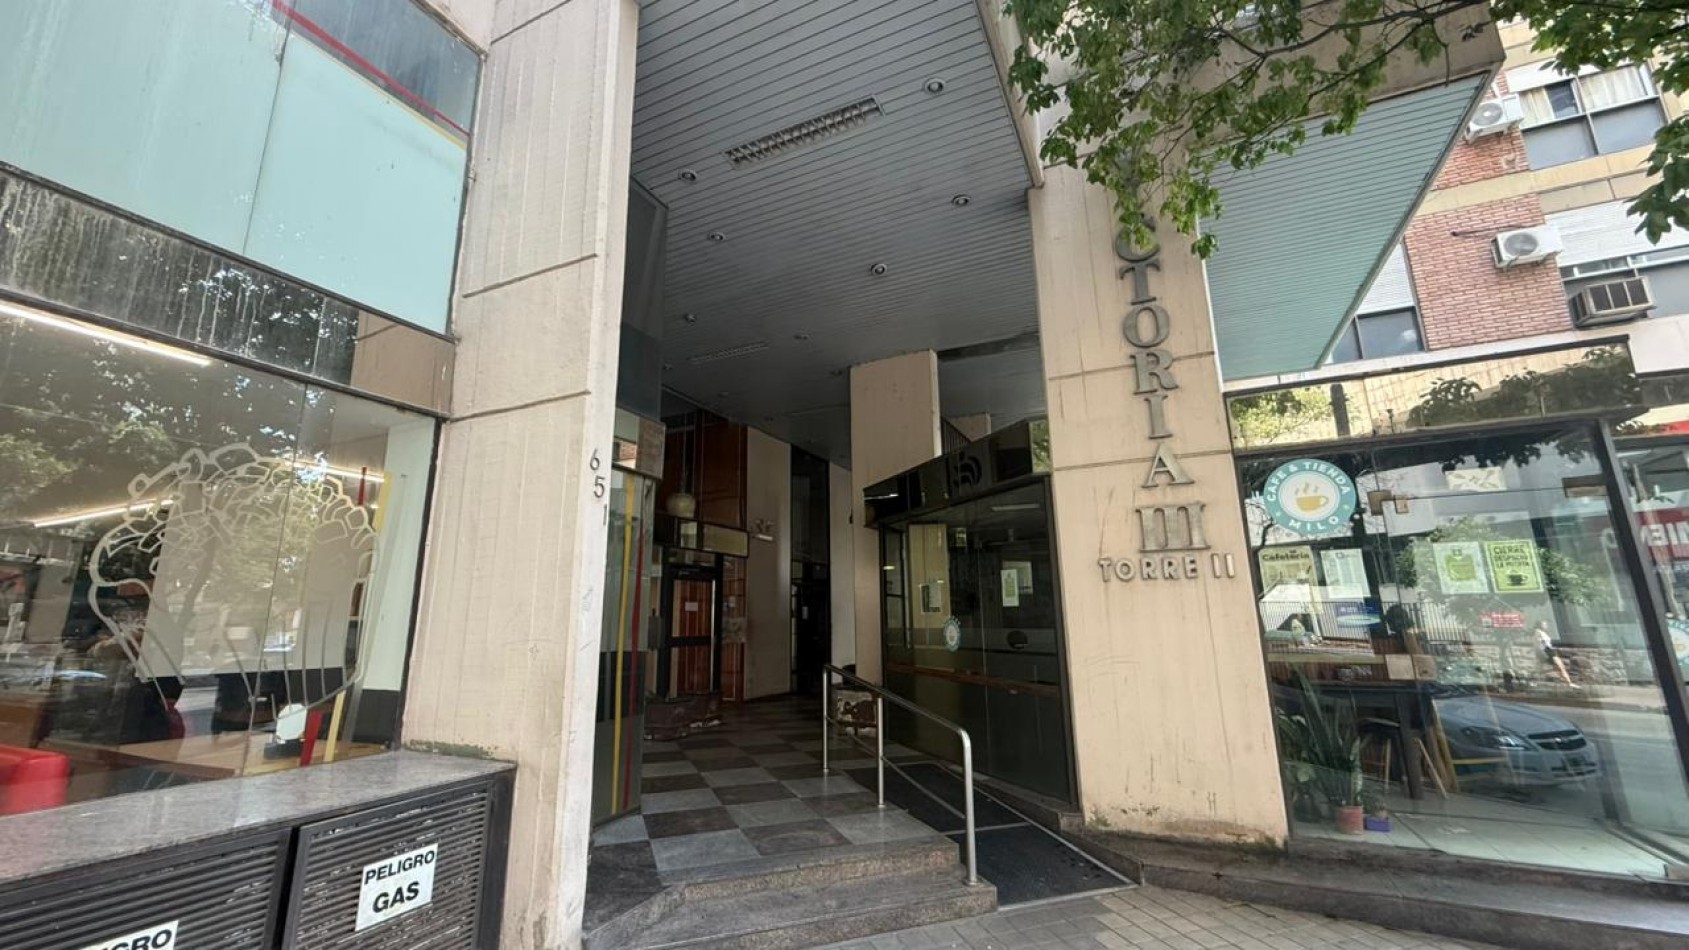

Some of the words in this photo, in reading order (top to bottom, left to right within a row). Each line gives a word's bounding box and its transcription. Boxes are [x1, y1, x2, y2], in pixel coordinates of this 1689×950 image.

[1303, 461, 1351, 495] TIENDA
[1288, 515, 1339, 531] MILO
[1098, 556, 1199, 584] TORRE
[1210, 552, 1236, 579] II
[364, 850, 435, 885] PELIGRO
[372, 881, 420, 913] GAS
